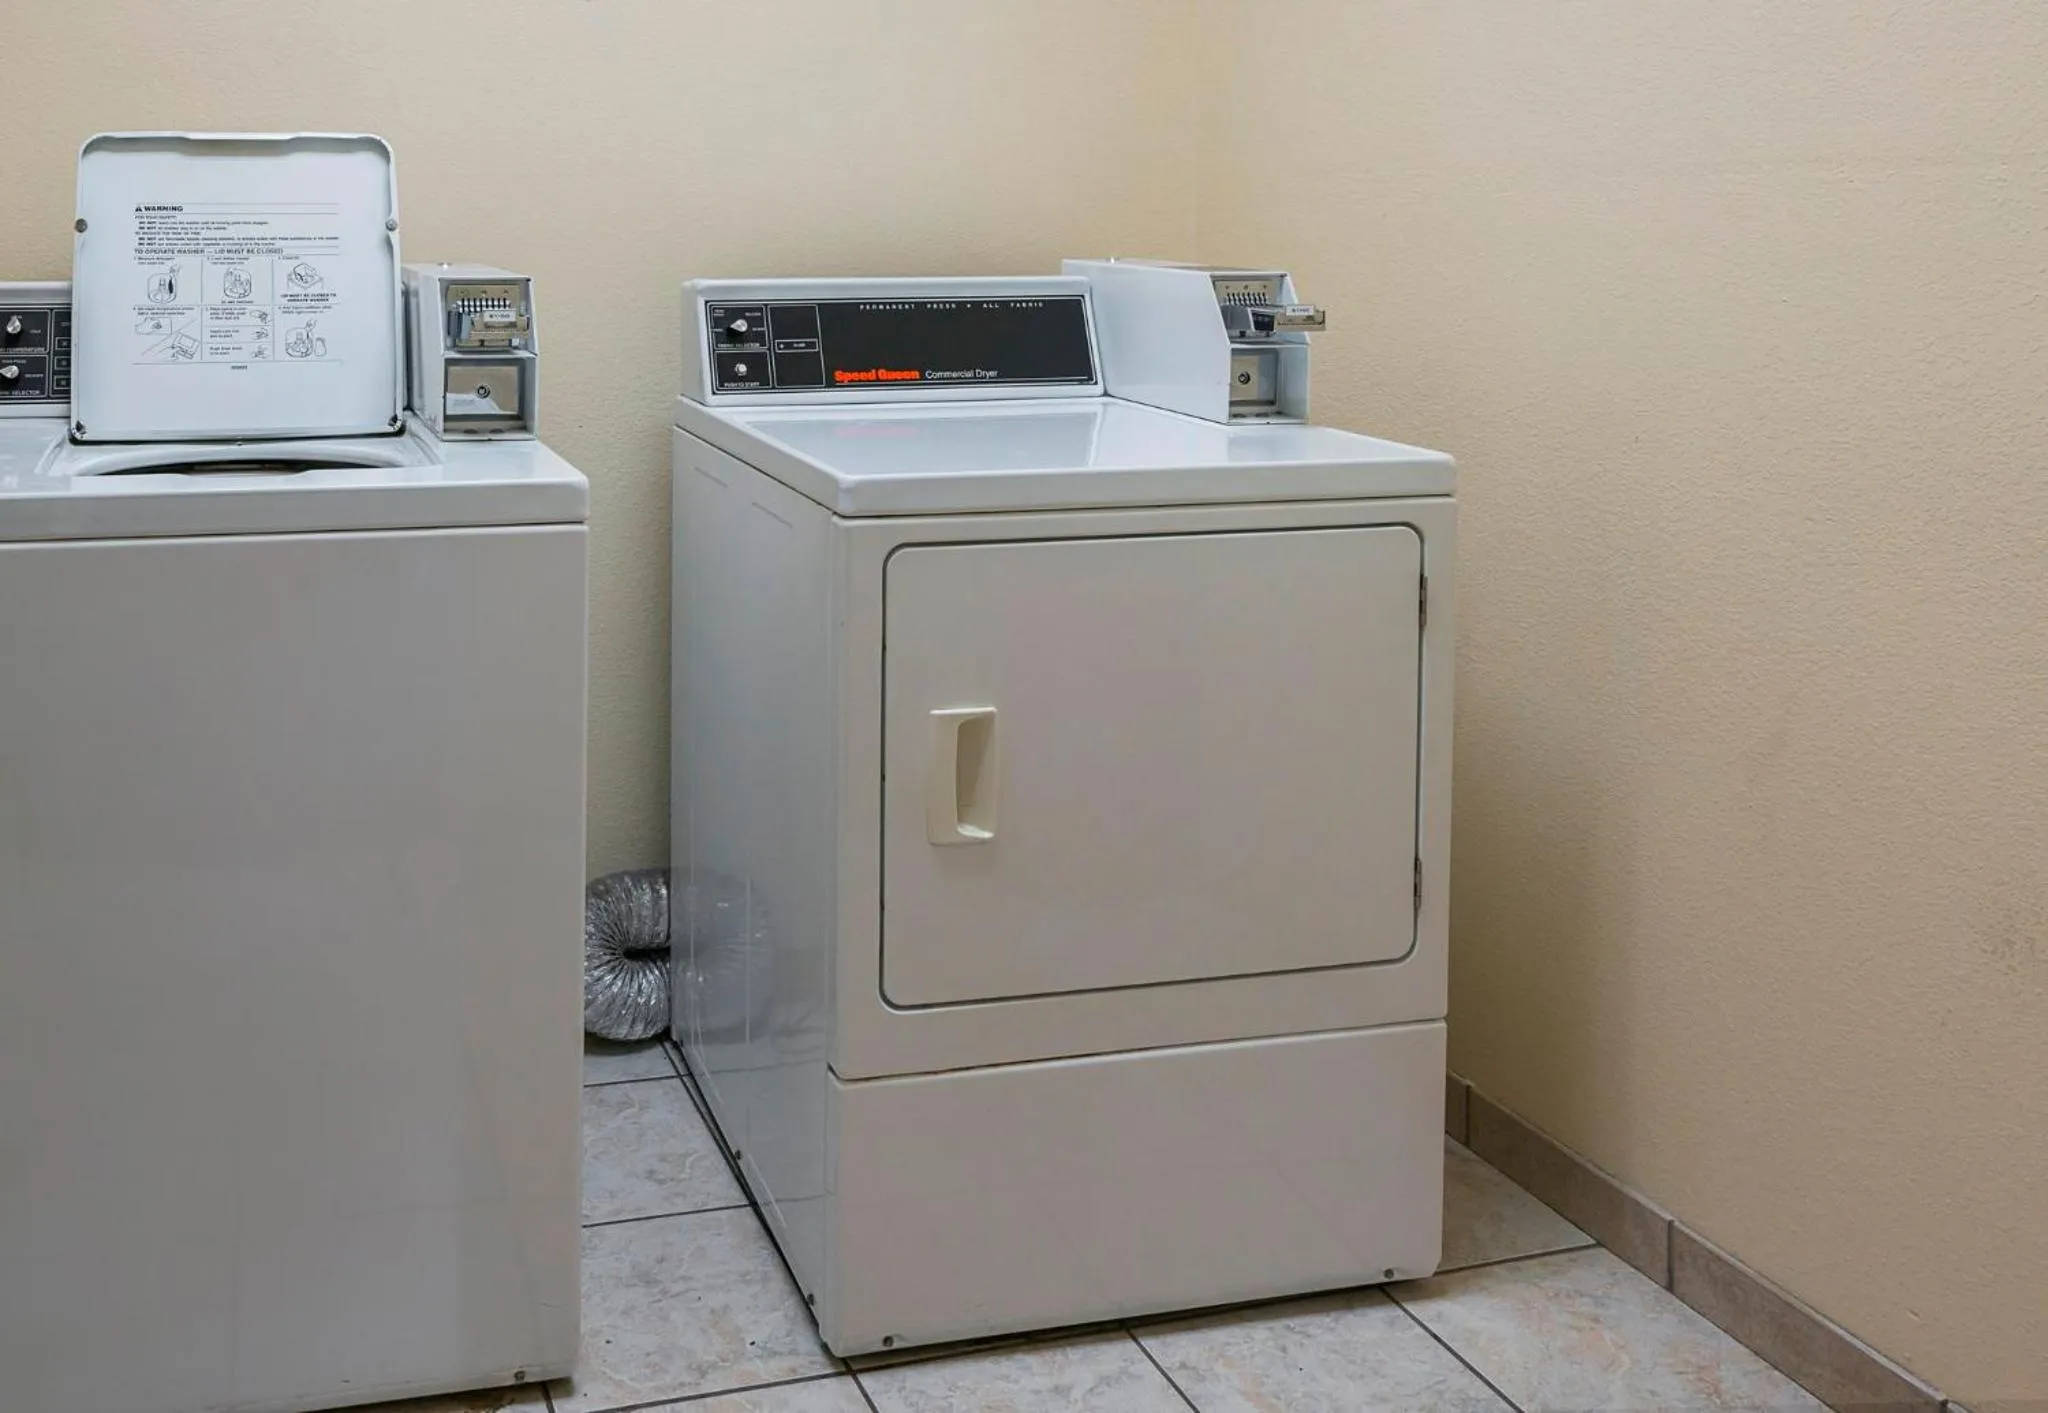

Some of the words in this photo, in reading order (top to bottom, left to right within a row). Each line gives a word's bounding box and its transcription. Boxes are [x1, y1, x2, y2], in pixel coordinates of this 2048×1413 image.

[834, 370, 876, 382] Speed
[878, 369, 920, 380] Queen
[925, 370, 974, 379] Commercial
[975, 369, 998, 379] Dryer
